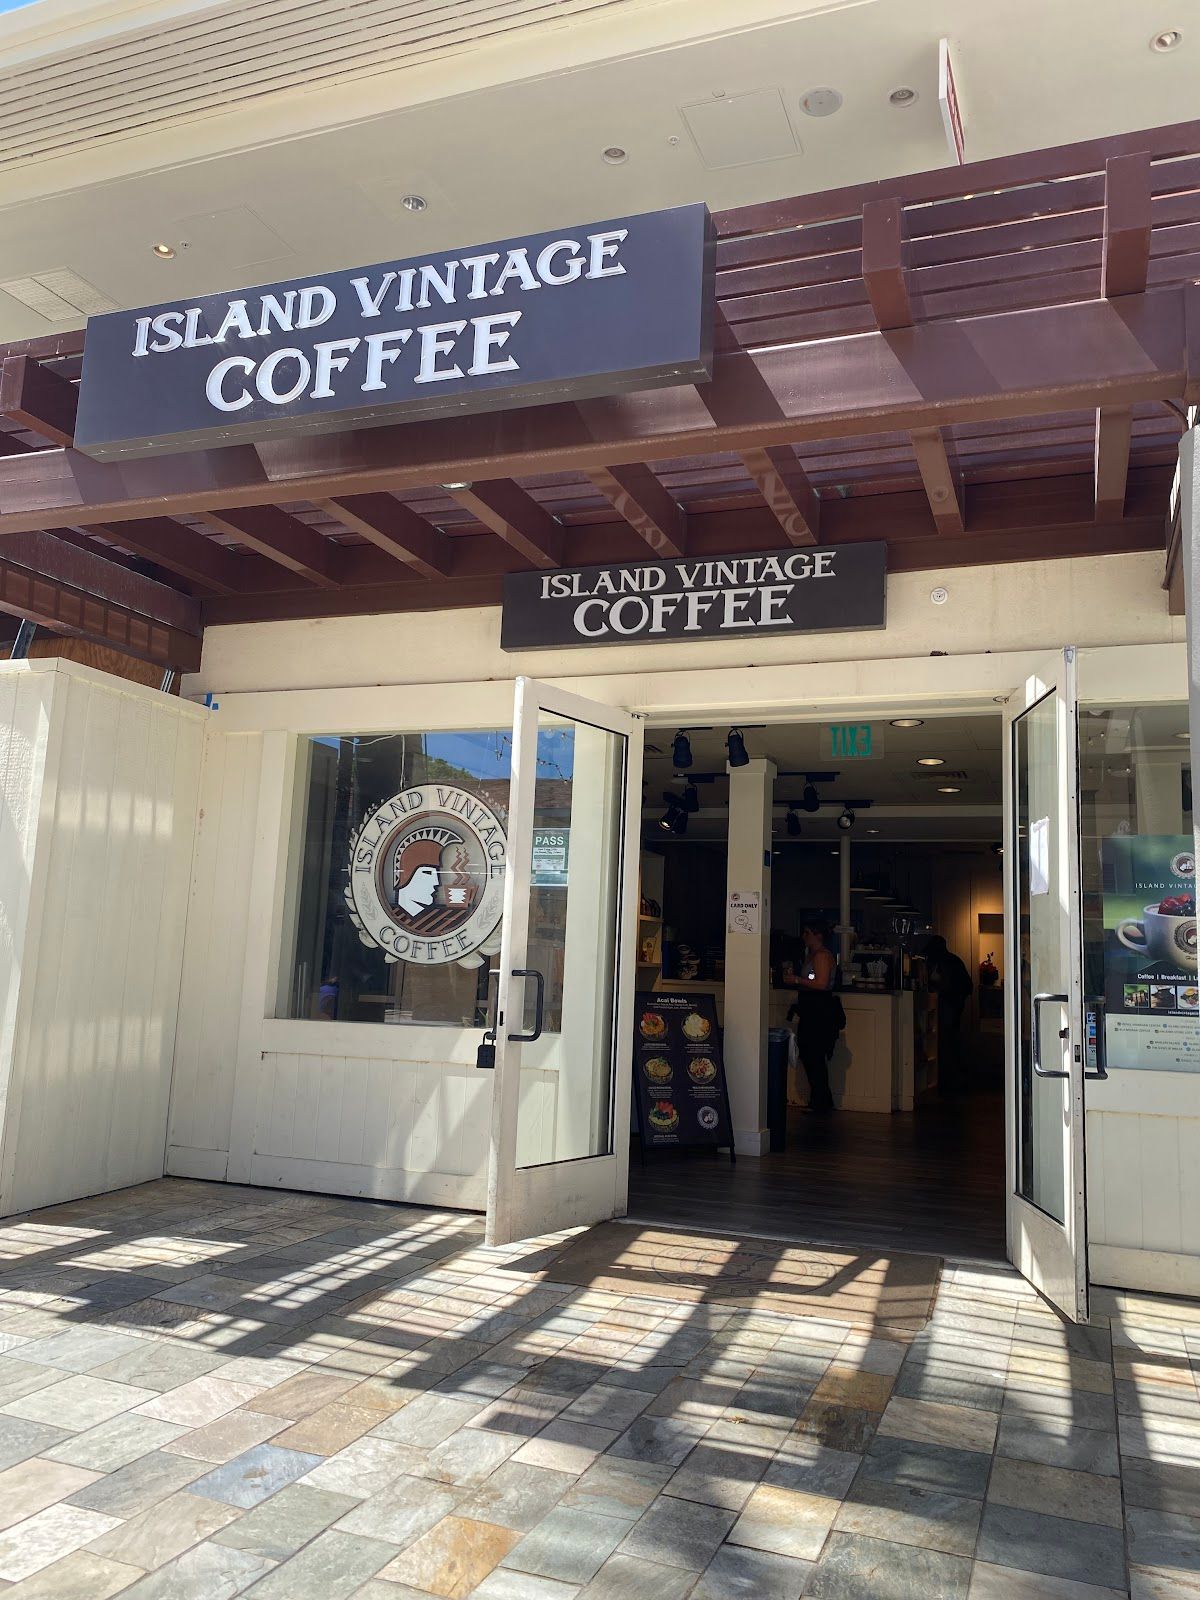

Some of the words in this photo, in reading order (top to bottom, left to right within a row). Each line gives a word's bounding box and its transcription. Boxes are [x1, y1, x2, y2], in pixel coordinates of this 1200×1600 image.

[131, 285, 338, 357] ISLAND
[349, 228, 630, 319] VINTAGE
[205, 310, 523, 413] COFFEE
[540, 566, 667, 600] ISLAND
[674, 551, 838, 588] VINTAGE
[573, 583, 796, 638] COFFEE
[355, 790, 424, 874] ISLAND
[535, 836, 564, 846] PASS
[379, 926, 474, 960] COFFEE
